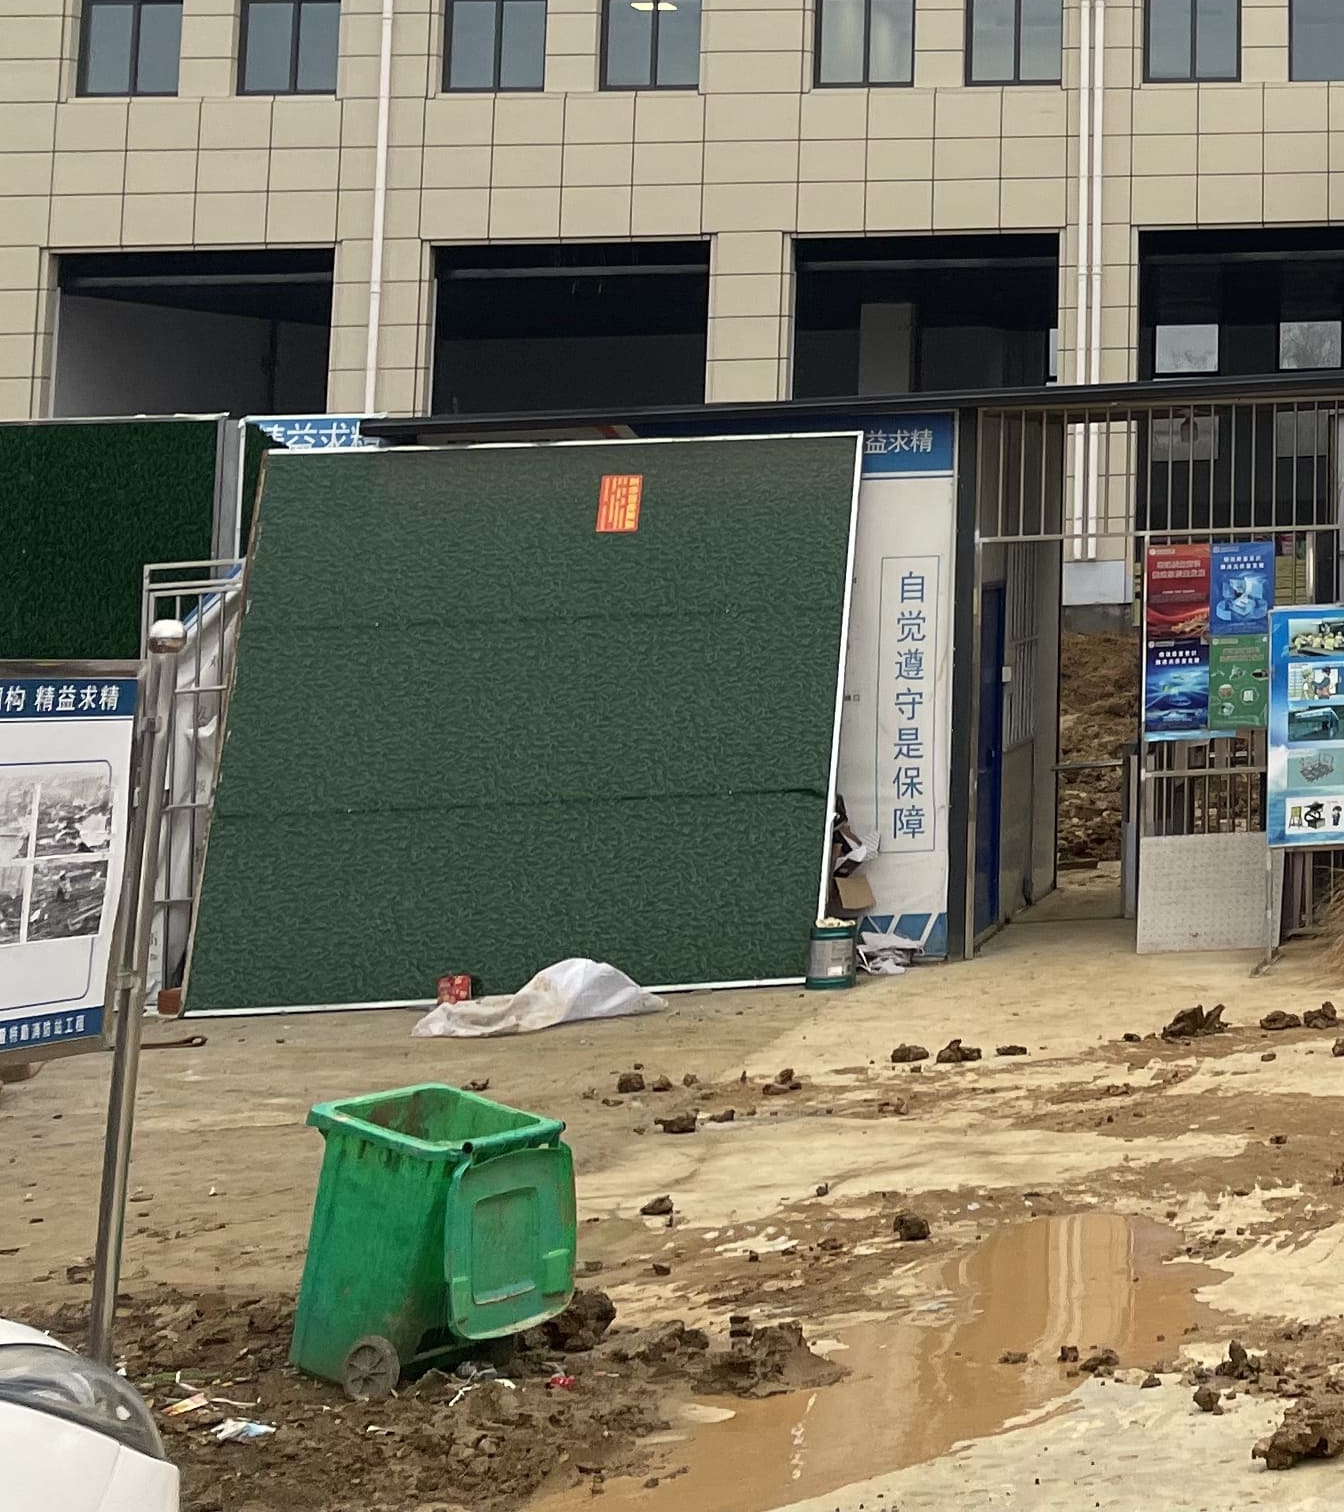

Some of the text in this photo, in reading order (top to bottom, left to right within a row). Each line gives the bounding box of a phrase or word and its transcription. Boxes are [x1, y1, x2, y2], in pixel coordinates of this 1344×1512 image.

[0, 684, 120, 712] 构 精益求精
[893, 571, 927, 840] 自觉遵守是保障
